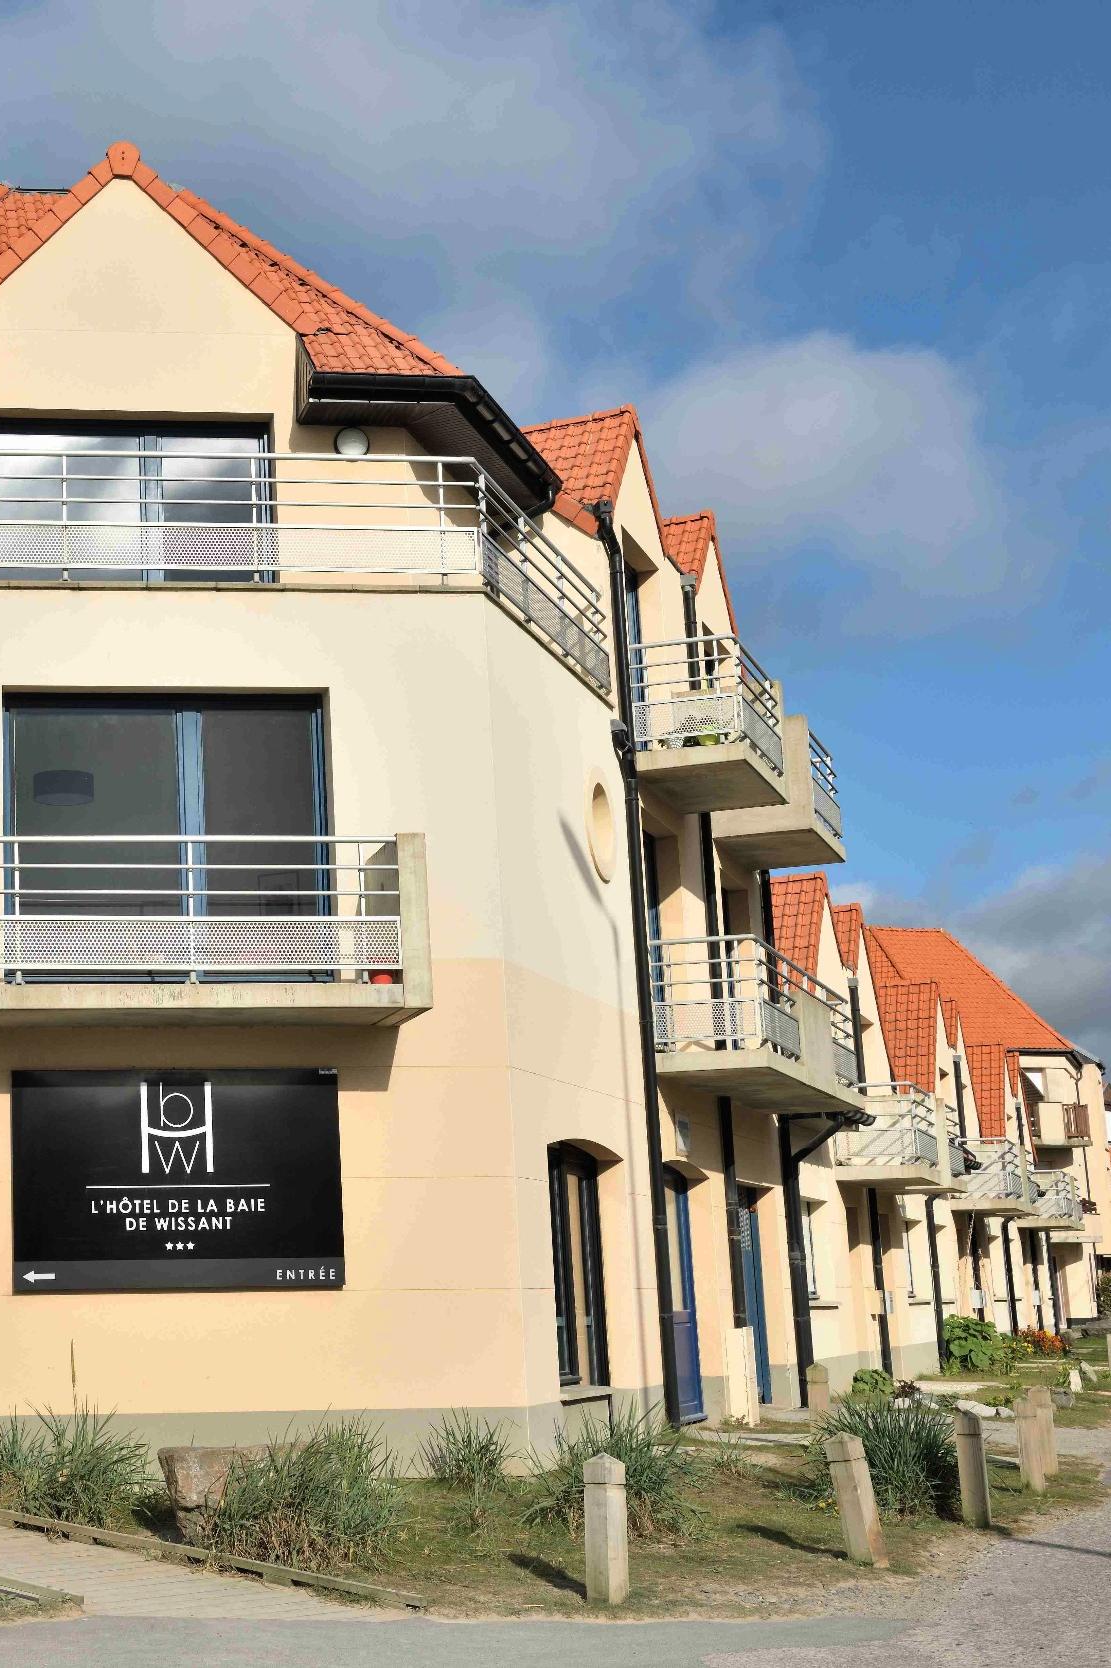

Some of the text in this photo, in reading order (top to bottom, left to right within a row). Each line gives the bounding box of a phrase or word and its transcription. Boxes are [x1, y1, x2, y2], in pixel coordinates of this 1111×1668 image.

[91, 1196, 265, 1214] L'HÔTEL DE LA BAIE
[125, 1216, 232, 1231] DE WISSANT
[276, 1265, 336, 1280] ENTRÉE
